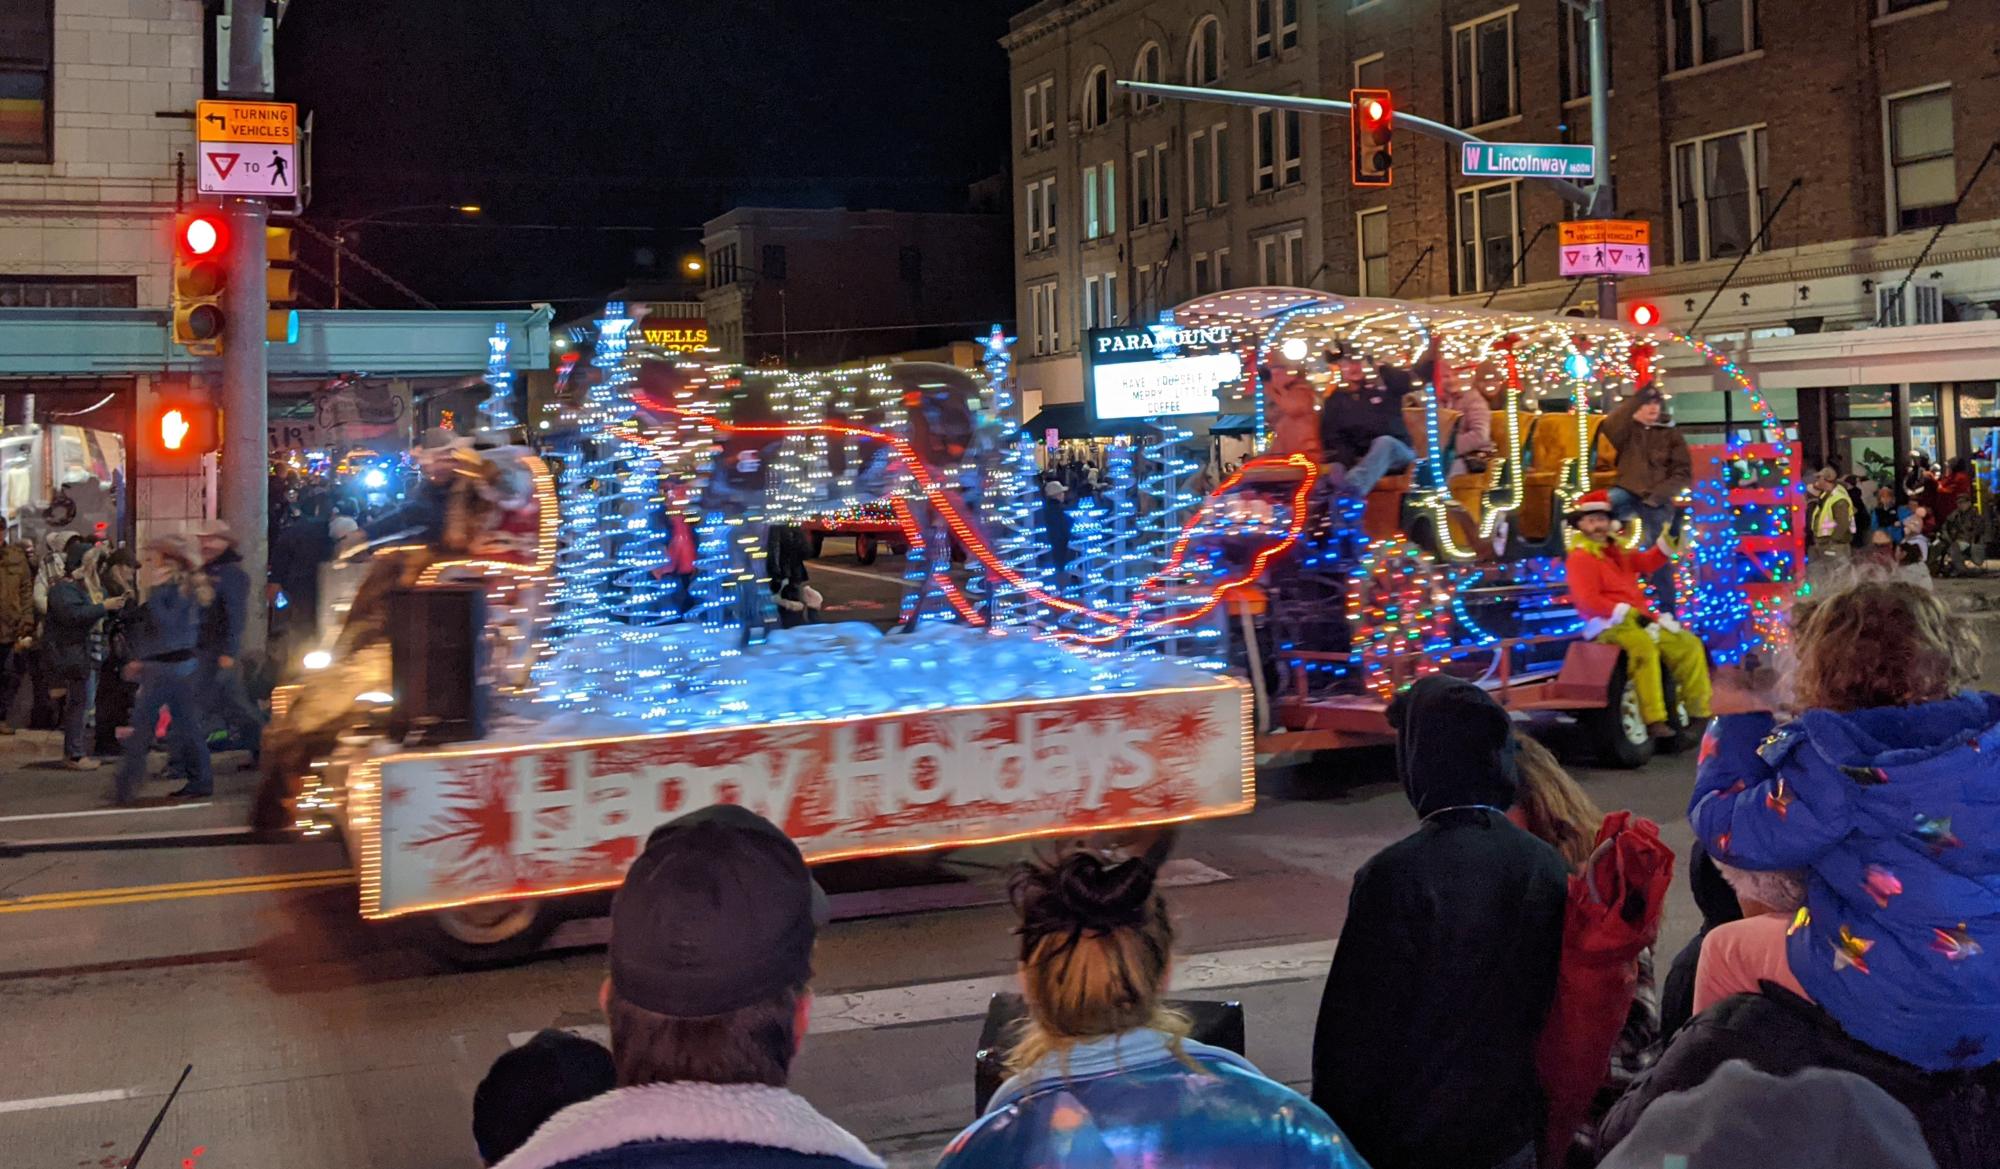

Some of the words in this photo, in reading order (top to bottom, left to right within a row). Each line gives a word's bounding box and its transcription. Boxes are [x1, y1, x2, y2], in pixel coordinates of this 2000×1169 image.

[233, 108, 288, 120] TURNING
[231, 125, 290, 137] VEHICLES
[244, 162, 260, 173] TO
[1466, 147, 1481, 170] W
[1488, 147, 1568, 175] Lincolnway
[644, 329, 708, 343] WELLS
[1122, 376, 1146, 389] HAVE
[1132, 389, 1164, 401] MERRY
[1147, 401, 1182, 415] COFFEE
[508, 745, 808, 868] Happy
[830, 709, 1158, 821] Holidays
